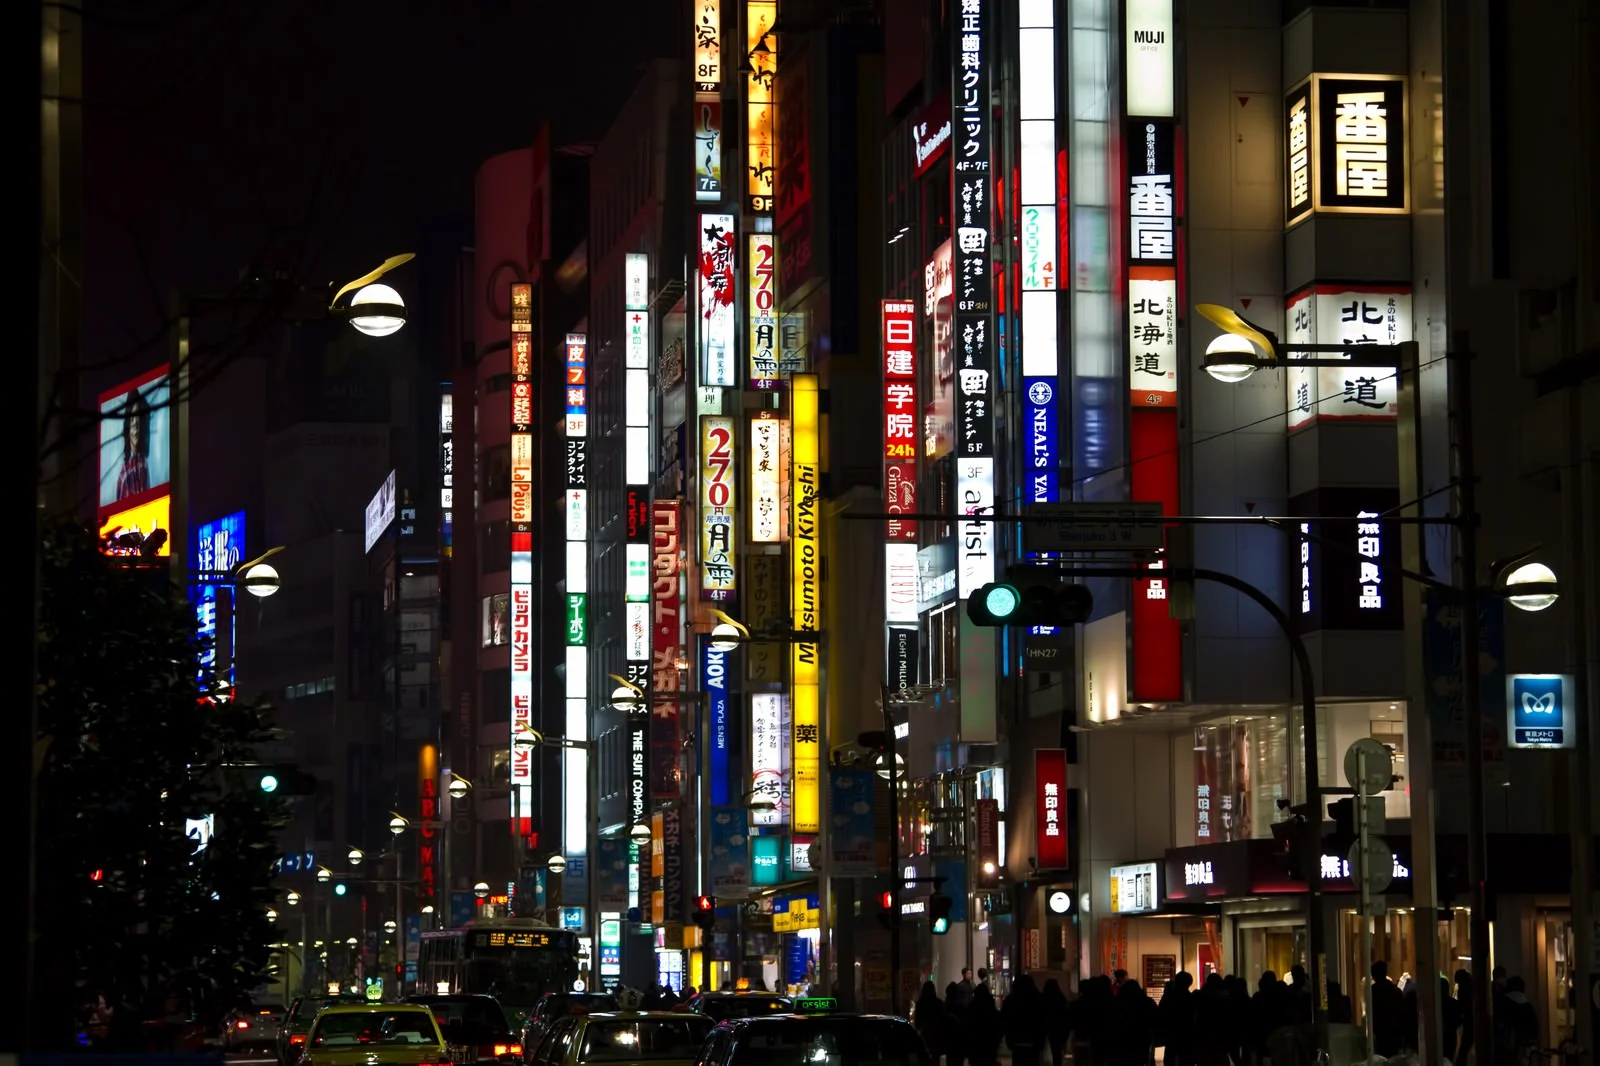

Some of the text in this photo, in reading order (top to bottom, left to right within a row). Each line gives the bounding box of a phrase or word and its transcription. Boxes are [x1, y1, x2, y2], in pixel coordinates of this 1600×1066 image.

[1134, 31, 1164, 44] MUJI
[698, 64, 717, 77] 8F
[700, 83, 715, 91] 7F
[962, 0, 980, 156] 矯正歯科クリニック
[1290, 96, 1308, 209] 番屋
[1336, 92, 1388, 197] 番屋
[700, 179, 717, 190] 7F
[752, 198, 773, 211] 9F
[1131, 174, 1172, 258] 番屋
[756, 244, 773, 310] 270
[960, 301, 974, 309] 6F
[1133, 299, 1166, 376] 北海道
[568, 346, 585, 405] 皮フ科
[757, 380, 773, 389] 4F
[887, 320, 913, 438] 日建学院
[1146, 394, 1162, 404] 4F
[569, 421, 584, 430] 3F
[1034, 408, 1049, 467] NEAL'S
[568, 441, 576, 483] コンタクト
[708, 428, 731, 506] 270
[887, 444, 914, 456] 24h
[968, 443, 983, 452] 5F
[514, 467, 530, 480] La
[889, 466, 901, 503] Ginza
[968, 467, 983, 478] 3F
[513, 484, 530, 520] Pausa
[628, 492, 637, 537] union
[714, 507, 724, 515] 円
[703, 524, 734, 587] 月の雫
[1357, 511, 1381, 608] 無印良品
[653, 511, 677, 718] コンタクト・メガネ
[710, 591, 727, 600] 4F
[799, 545, 815, 664] Mtsumoto
[514, 591, 528, 671] ビックカメラ
[899, 634, 907, 692] EIGHT MILLIO
[628, 666, 637, 713] コント
[514, 695, 528, 777] ビックメラ
[633, 730, 642, 751] THE
[796, 724, 817, 744] 薬
[633, 753, 643, 777] SUIT
[421, 779, 435, 838] ABC
[1045, 783, 1059, 836] 無印良品
[1185, 862, 1214, 886] 無印良品
